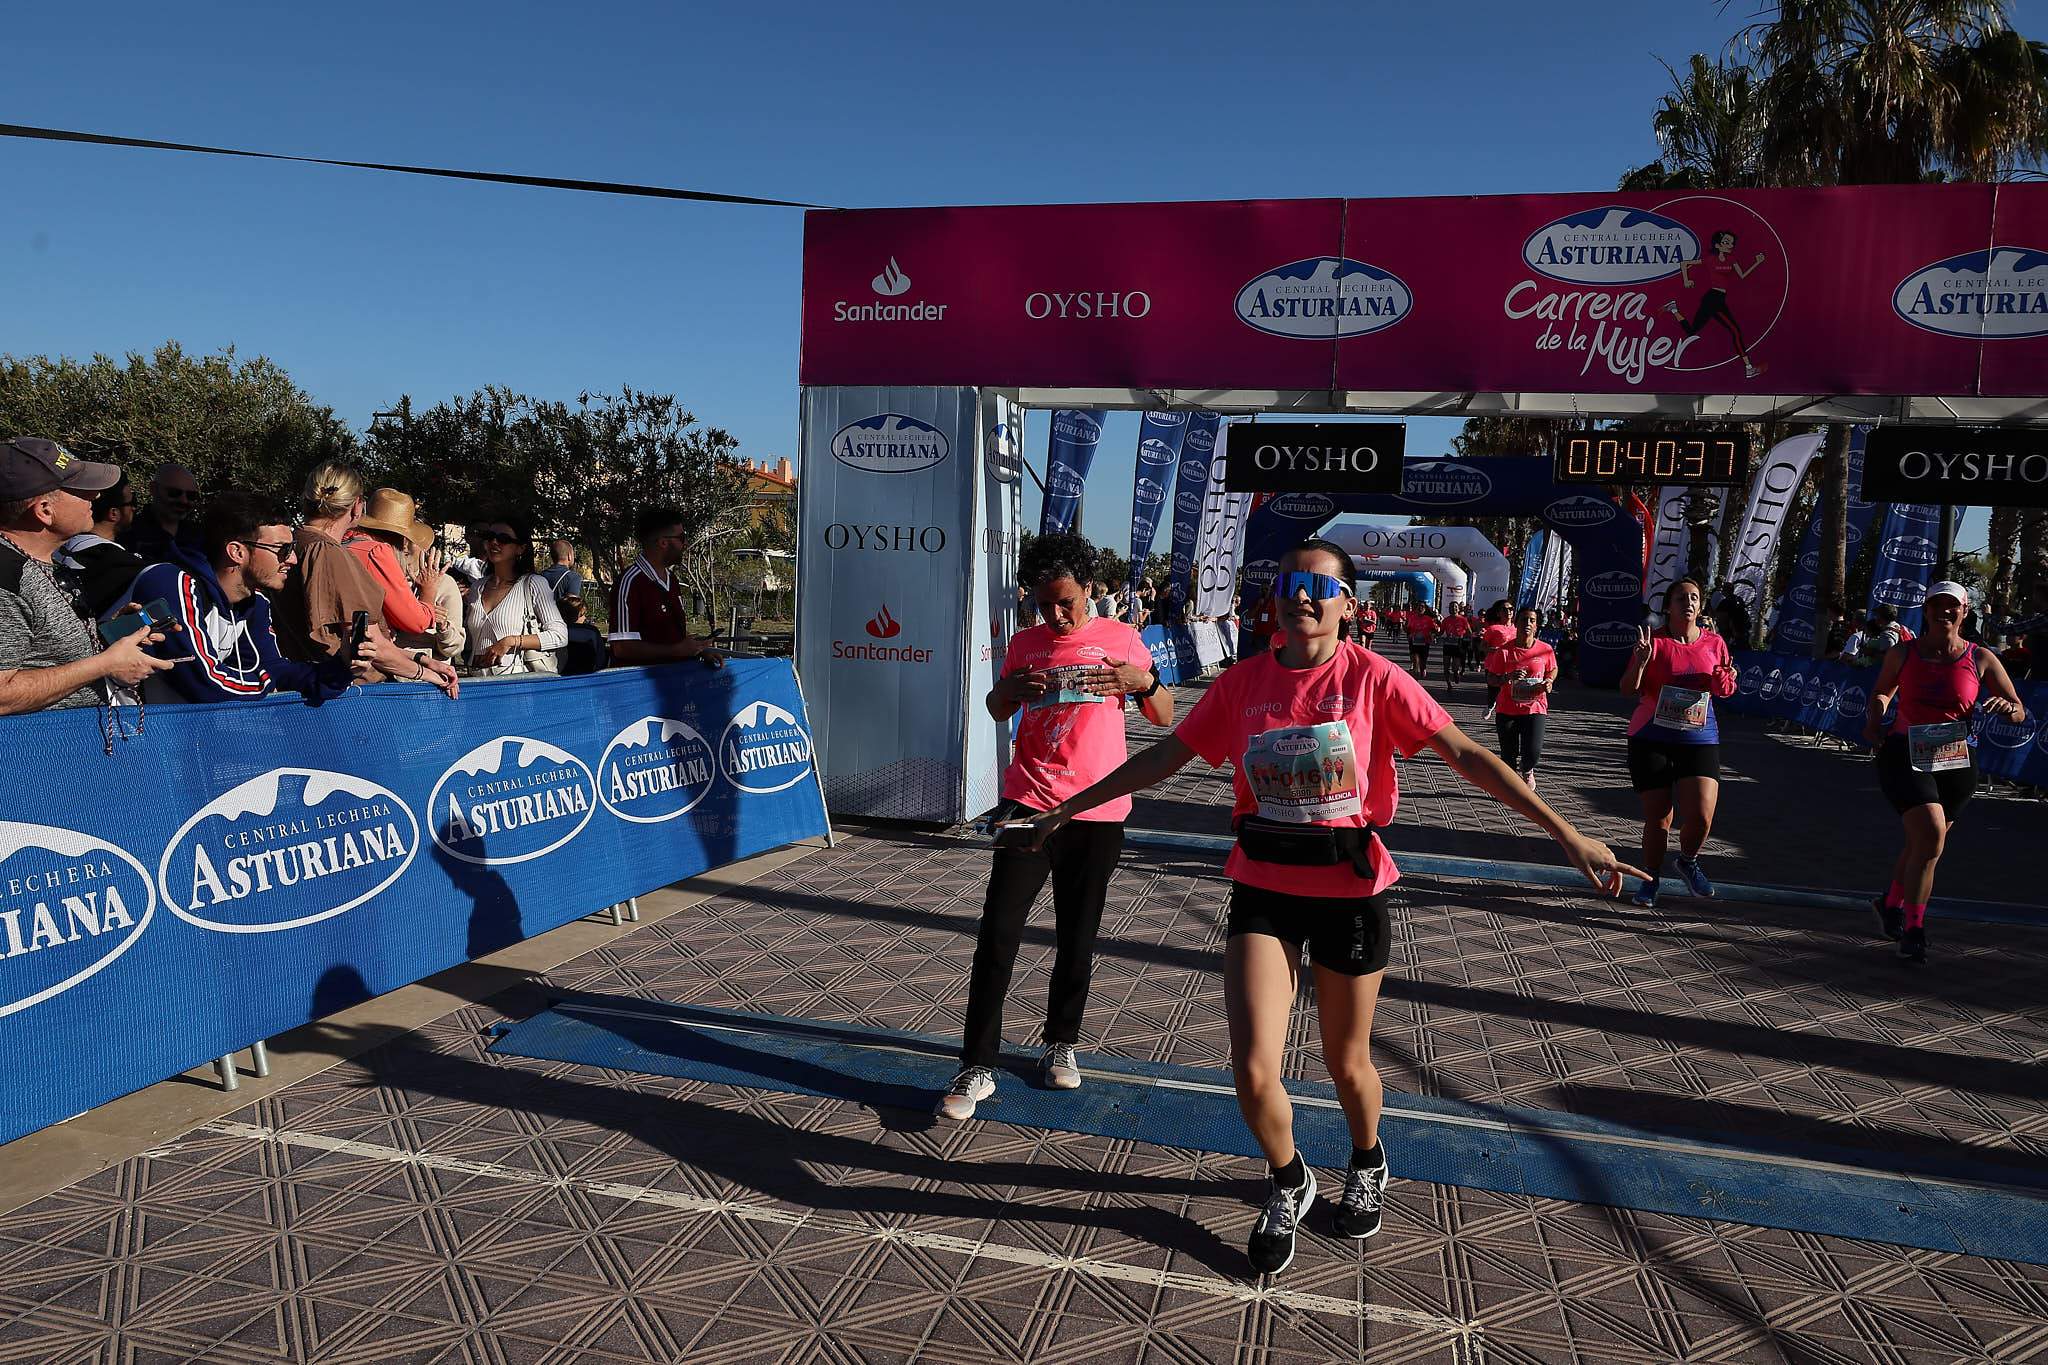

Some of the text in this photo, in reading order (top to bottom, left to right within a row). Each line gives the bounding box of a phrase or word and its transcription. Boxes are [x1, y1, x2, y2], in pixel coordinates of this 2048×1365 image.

[1563, 233, 1683, 242] CENTRAL LECHERA
[1535, 242, 1685, 267] ASTURIANA
[1275, 283, 1394, 295] CENTRAL ECHERA
[1943, 278, 2011, 290] CENTRAL
[833, 299, 947, 323] Santander
[1024, 290, 1152, 320] OYSHO
[1247, 286, 1397, 320] ASTURIANA
[1503, 280, 1648, 322] Carrera
[1535, 316, 1701, 385] de la Mujer
[838, 435, 941, 460] ASTURIANA
[1254, 444, 1380, 473] OYSHO
[1568, 438, 1735, 477] 00:40:37
[1898, 450, 2048, 484] OYSHO
[1274, 500, 1330, 513] ASTURIANA
[1550, 505, 1612, 520] ASTURIANA
[823, 523, 947, 553] OYSHO
[1362, 530, 1447, 550] OYSHO
[831, 641, 934, 664] Santander
[738, 732, 769, 745] CENTRAL
[624, 743, 703, 767] CENTRAL LECHERA
[467, 767, 579, 800] CENTRAL LECHERA
[609, 757, 710, 804] ASTURIANA
[224, 803, 391, 850] CENTRAL LECHERA
[446, 784, 589, 844] ASTURIANA
[0, 860, 113, 898] ECHERA
[188, 822, 408, 911] ASTURIANA
